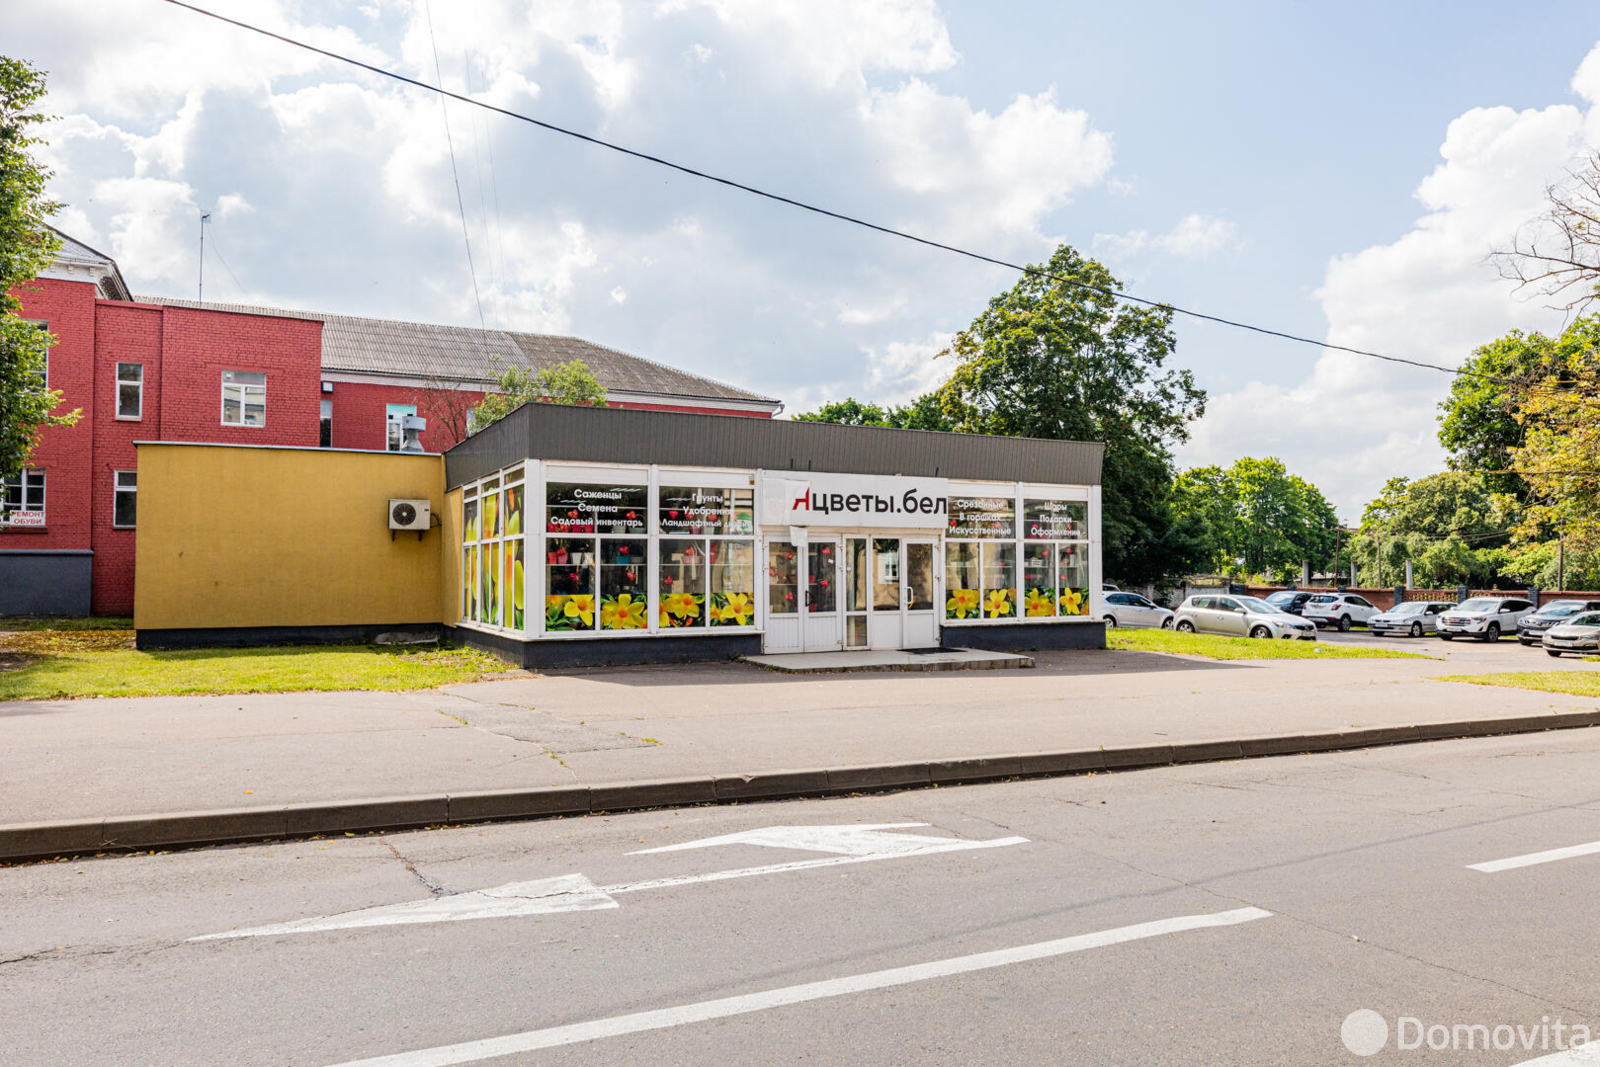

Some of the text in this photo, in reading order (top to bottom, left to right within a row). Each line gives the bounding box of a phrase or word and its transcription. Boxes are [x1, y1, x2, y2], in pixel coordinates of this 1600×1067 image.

[574, 489, 622, 499] Саженцы
[692, 493, 724, 503] Грунты
[578, 503, 618, 513] Семена
[683, 506, 734, 516] Удобрения
[1044, 502, 1067, 512] Шары
[550, 516, 643, 528] Садовый инвентарь
[662, 518, 722, 528] Ландшафтный
[1040, 514, 1073, 524] Подарки
[949, 526, 1012, 536] Искусственные
[1030, 526, 1081, 538] Оформление
